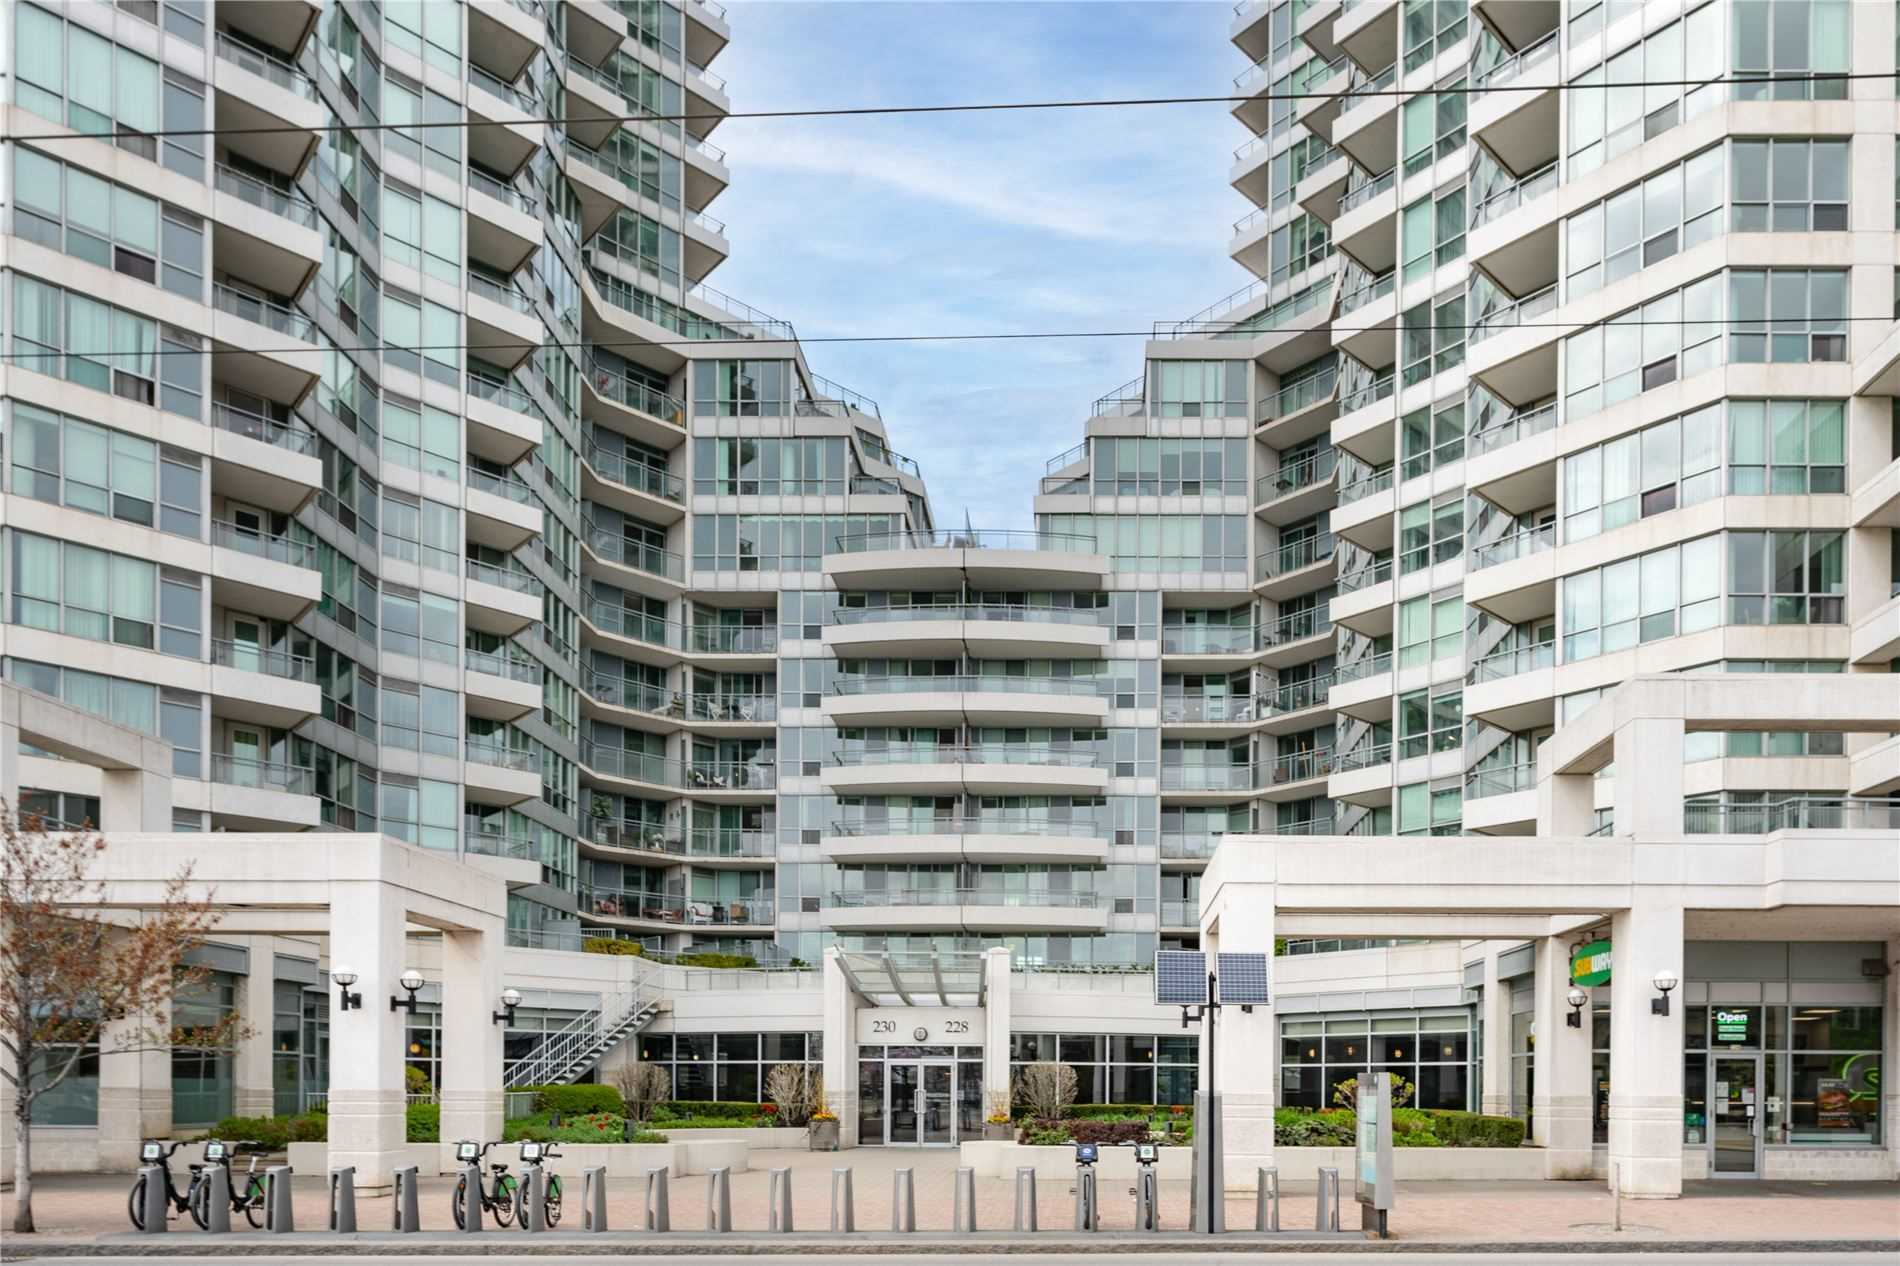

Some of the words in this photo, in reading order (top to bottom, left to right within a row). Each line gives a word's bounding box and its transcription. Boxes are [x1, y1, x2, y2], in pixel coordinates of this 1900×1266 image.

[1717, 1012, 1747, 1023] Open
[873, 1020, 896, 1033] 230
[945, 1020, 969, 1033] 228
